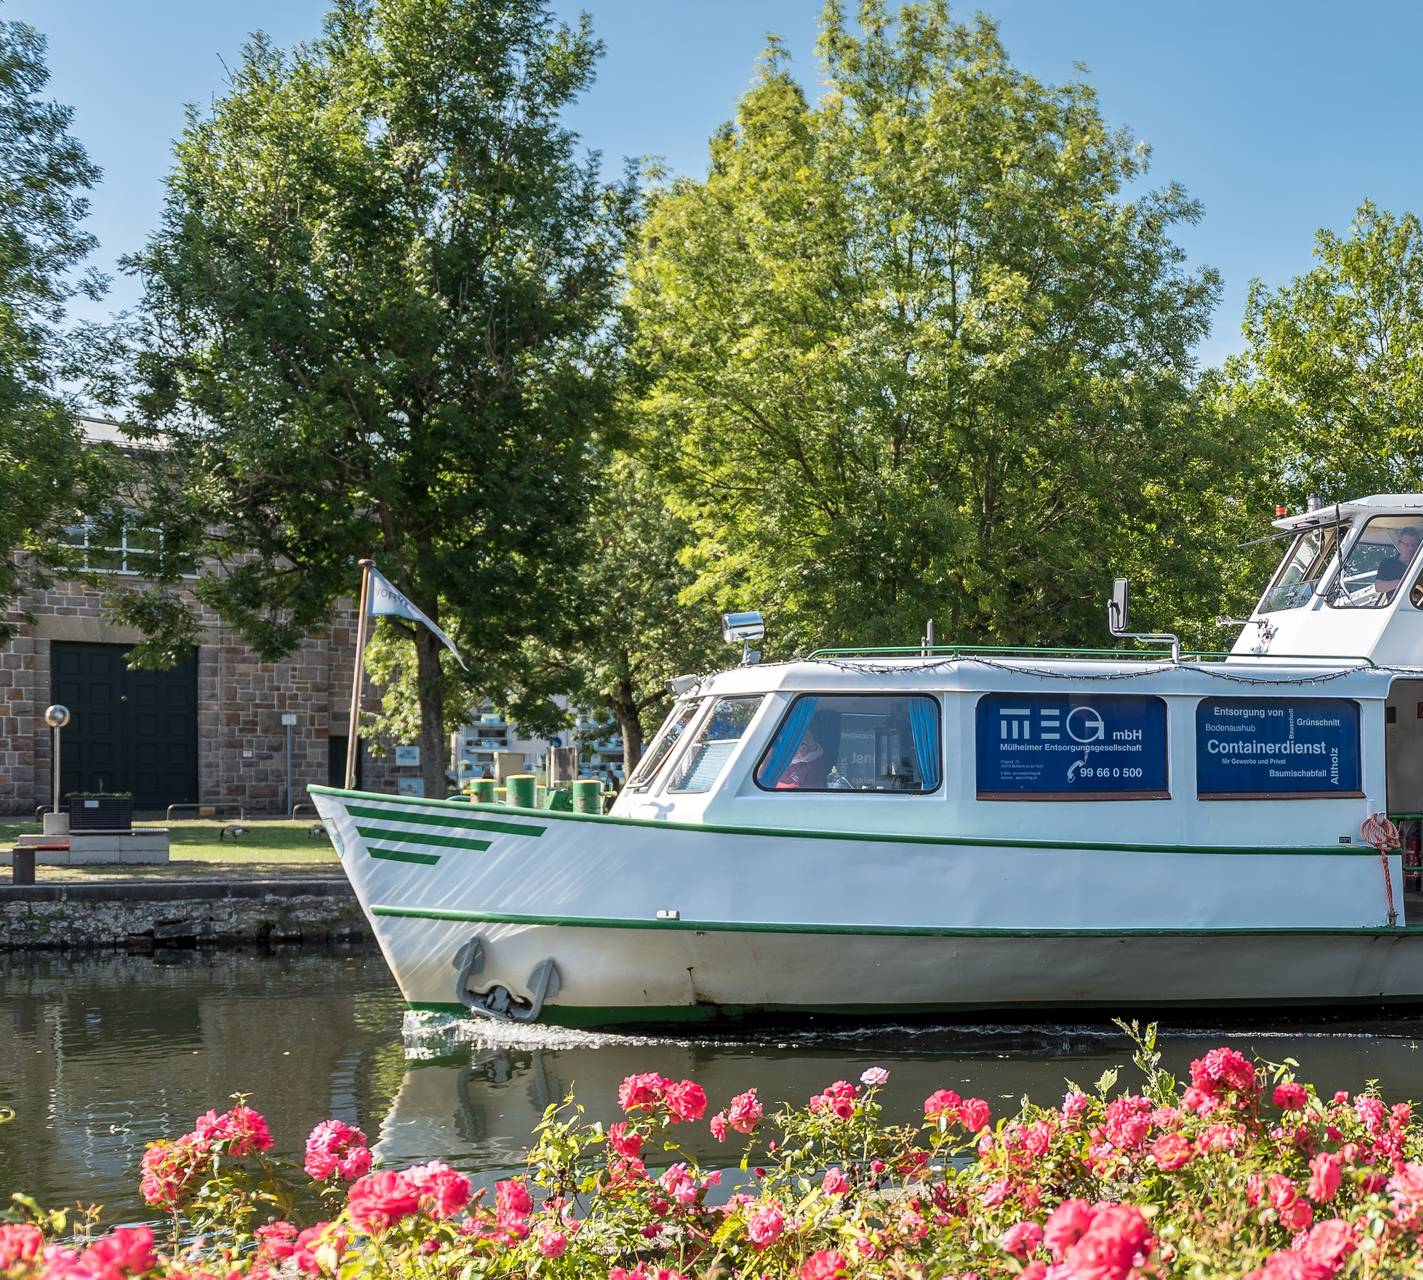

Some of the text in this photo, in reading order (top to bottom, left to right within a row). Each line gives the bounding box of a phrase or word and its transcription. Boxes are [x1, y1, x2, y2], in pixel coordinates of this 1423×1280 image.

[1213, 706, 1284, 719] Entsorgung von
[1296, 717, 1341, 727] Grünschnitt
[1205, 723, 1256, 732] Bodenaushub
[1112, 729, 1143, 741] mbH
[1000, 743, 1143, 753] Mülheimer Entsorgungsgesellschaft
[1207, 738, 1327, 754] Containerdienst
[1221, 757, 1230, 765] für
[1231, 757, 1257, 765] Gewerbe
[1257, 757, 1269, 765] und
[1330, 747, 1339, 785] Altholz
[1080, 767, 1143, 778] 99 66 0 500
[1269, 769, 1327, 778] Baumischabfall
